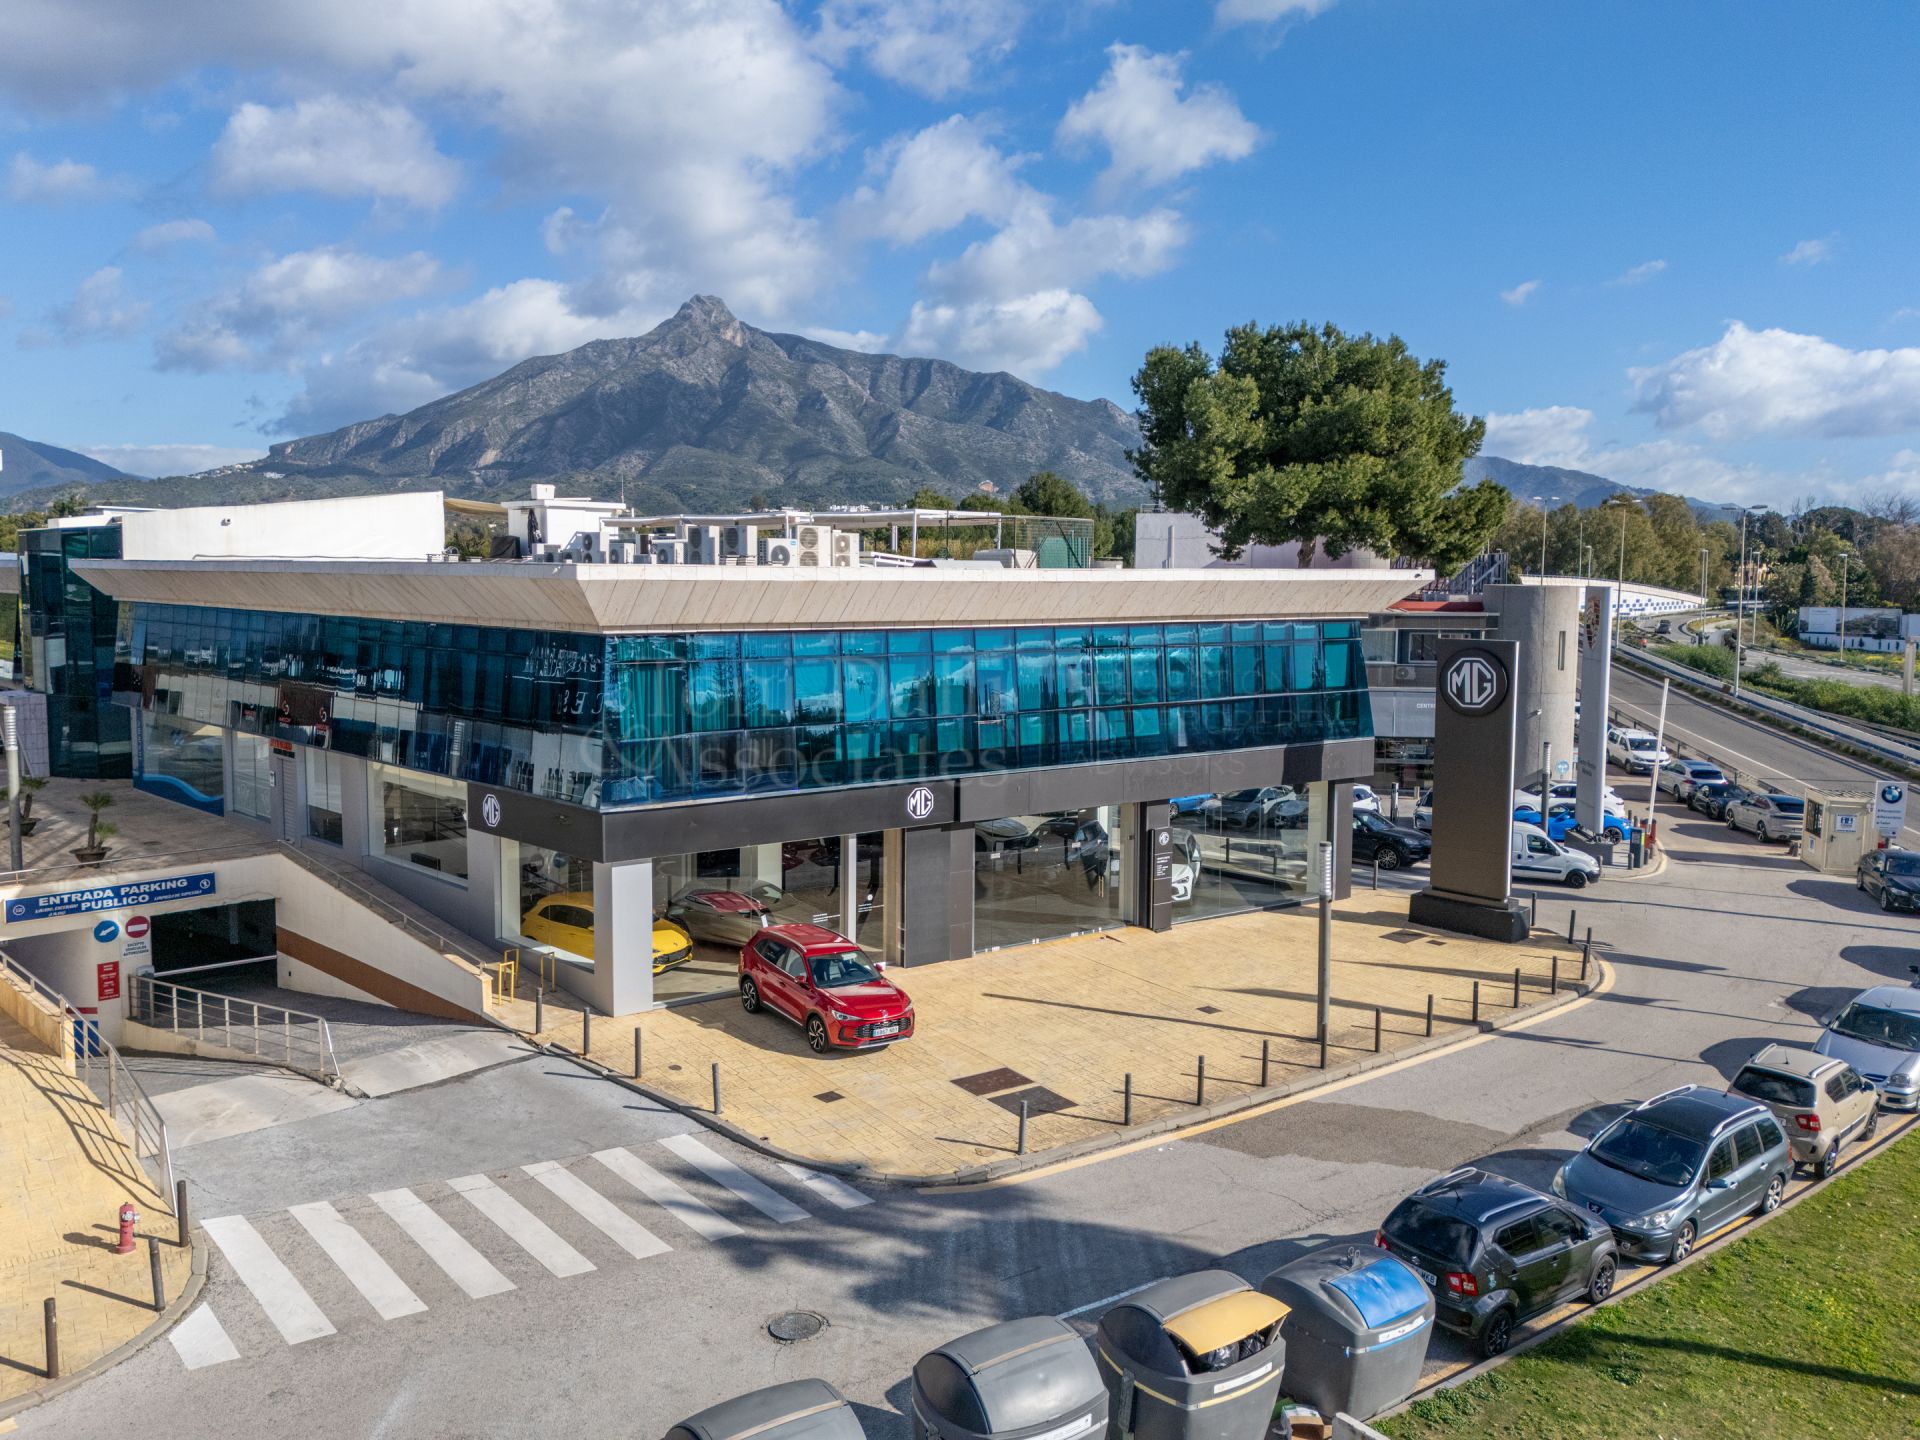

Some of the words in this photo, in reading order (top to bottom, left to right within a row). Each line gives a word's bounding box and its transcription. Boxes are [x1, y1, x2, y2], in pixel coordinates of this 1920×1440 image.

[1450, 660, 1494, 705] MG
[484, 796, 500, 826] MG
[909, 788, 933, 818] MG
[39, 889, 114, 907] ENTRADA
[120, 878, 188, 896] PARKING
[81, 894, 150, 911] PUBLICO
